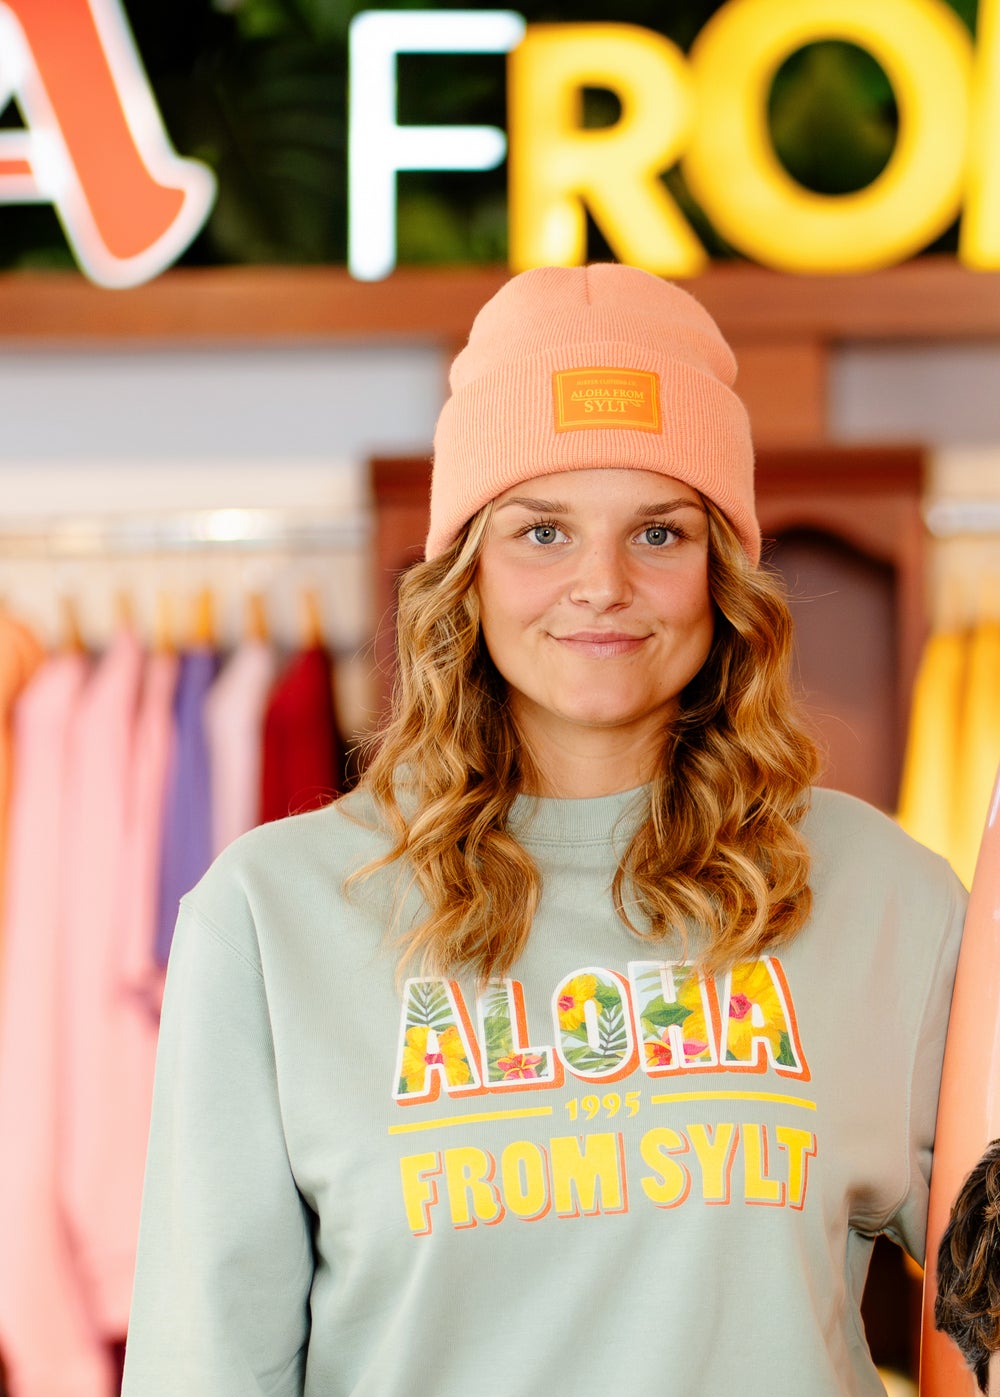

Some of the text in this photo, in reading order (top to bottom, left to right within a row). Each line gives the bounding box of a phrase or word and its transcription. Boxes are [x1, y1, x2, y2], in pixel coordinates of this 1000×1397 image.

[571, 388, 645, 400] ALOHA FROM
[584, 400, 627, 413] SYLT
[391, 955, 812, 1107] ALOHA
[564, 1091, 642, 1121] 1995
[400, 1123, 818, 1237] FROM SYLT
